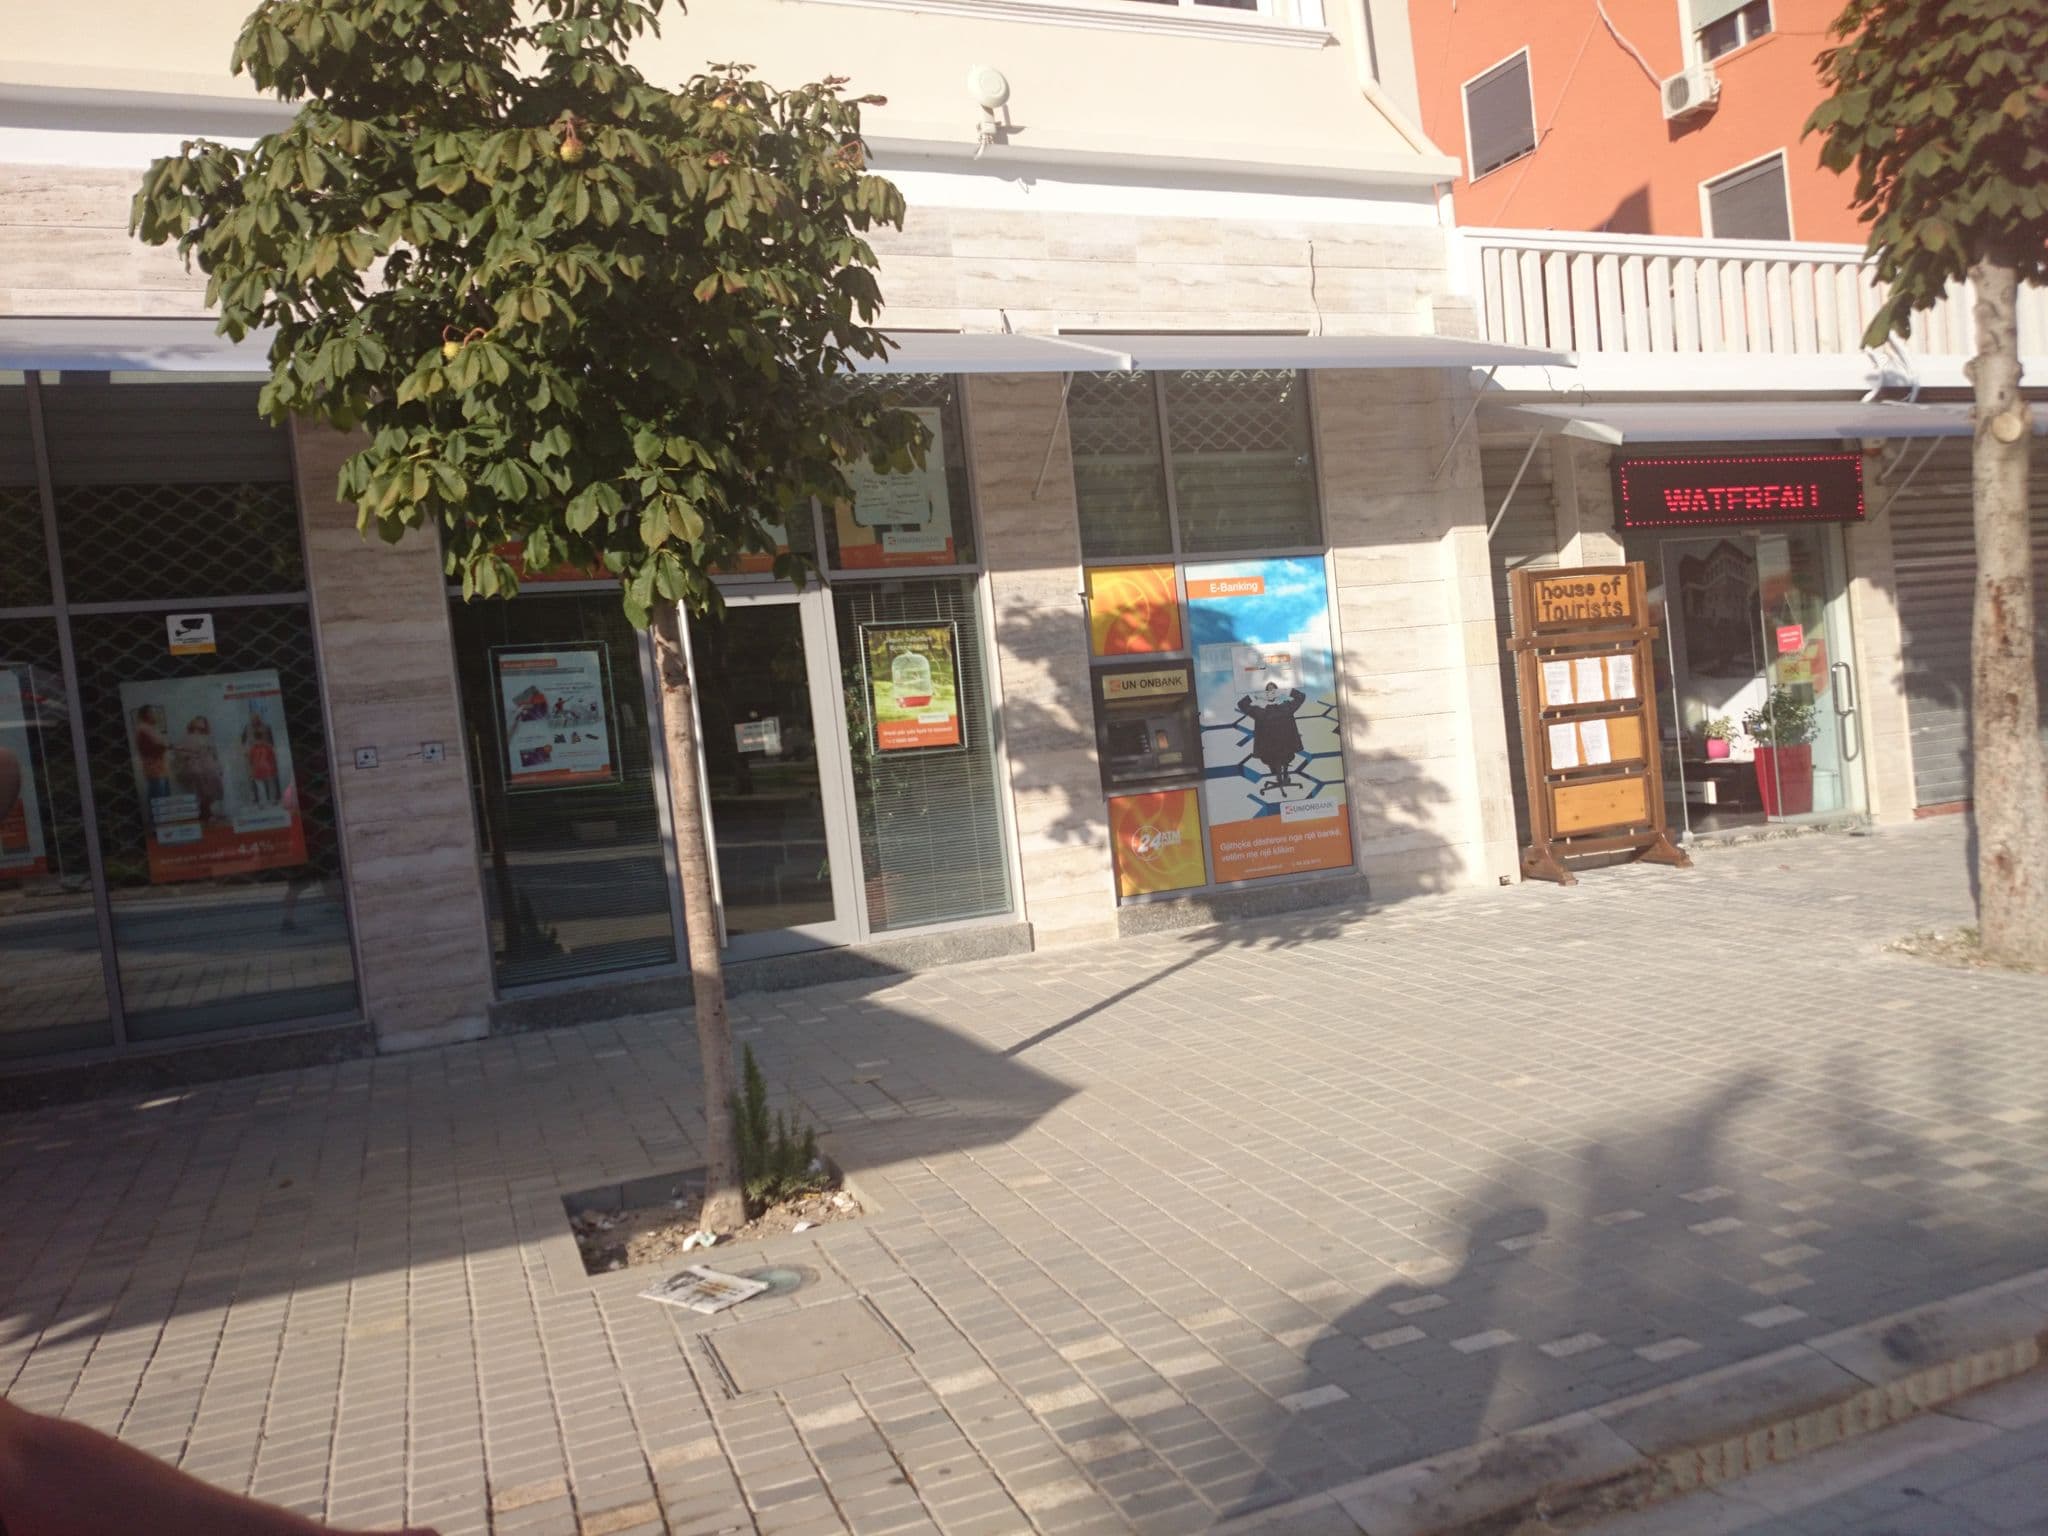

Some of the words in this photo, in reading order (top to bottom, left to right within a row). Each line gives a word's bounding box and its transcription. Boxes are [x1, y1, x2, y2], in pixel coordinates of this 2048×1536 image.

[1209, 581, 1259, 593] E-Banking
[1541, 581, 1595, 600] house
[1600, 576, 1621, 596] of
[1542, 596, 1624, 621] Tourists
[1121, 676, 1183, 690] UNONBANK
